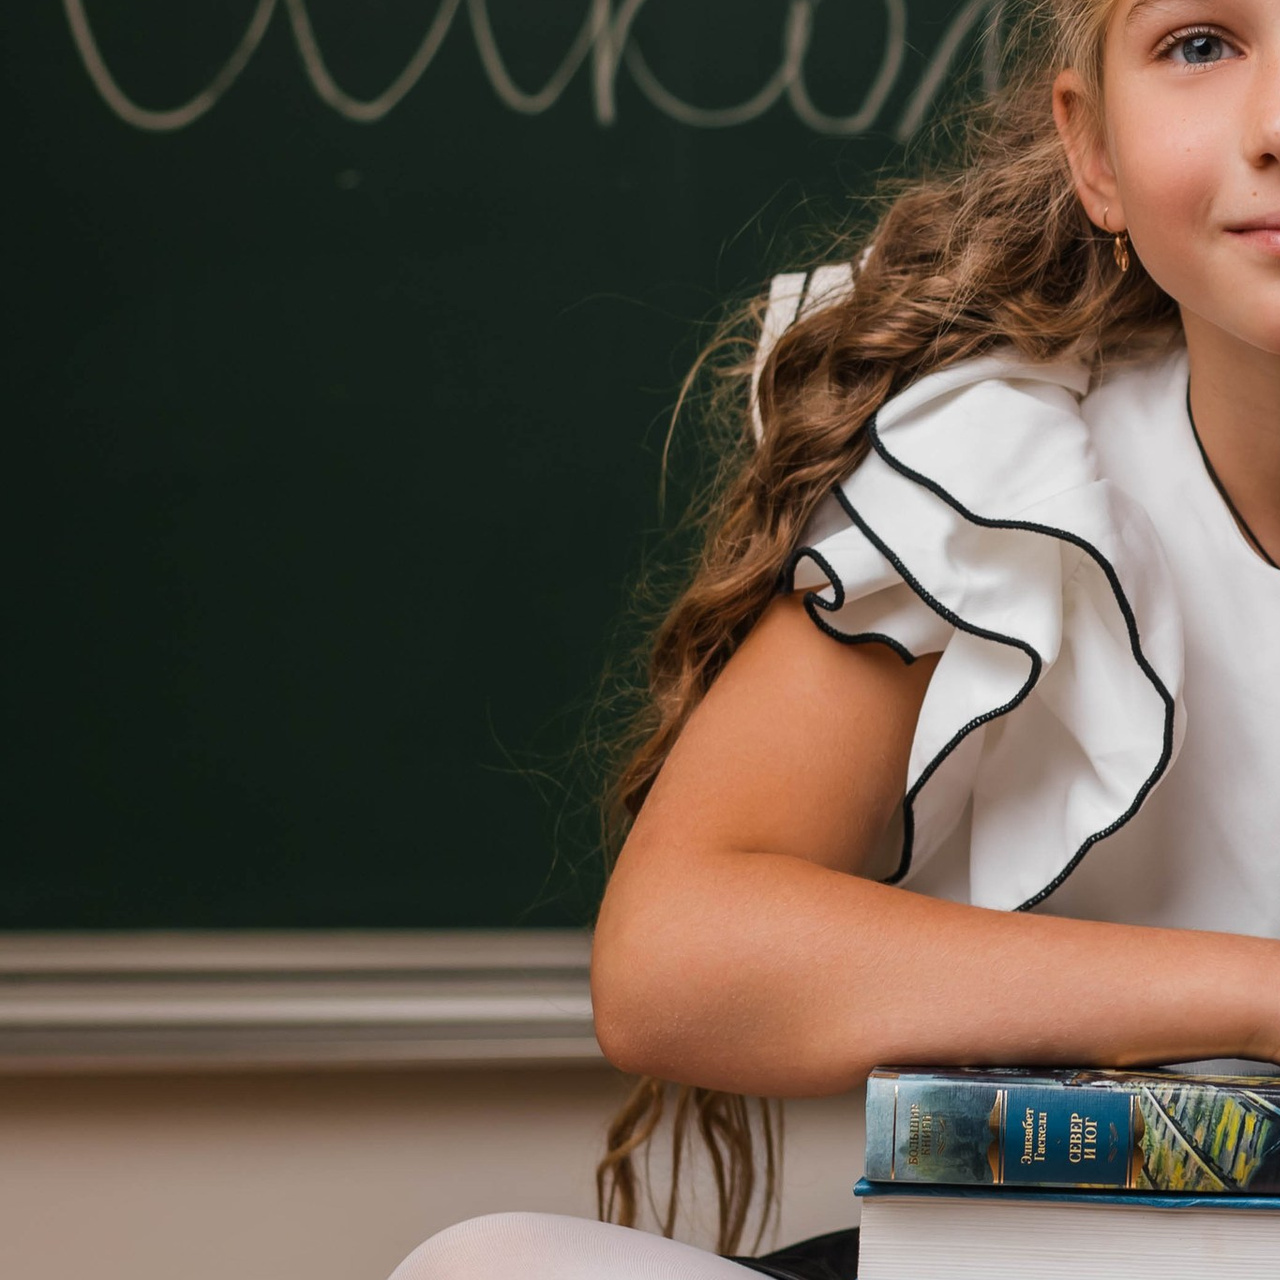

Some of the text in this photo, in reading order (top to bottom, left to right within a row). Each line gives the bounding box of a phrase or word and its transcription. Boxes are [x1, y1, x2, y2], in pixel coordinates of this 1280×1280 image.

[1020, 1107, 1034, 1165] Элизабет
[1033, 1112, 1047, 1161] Гаскелл
[1069, 1112, 1083, 1163] СЕВЕР
[1083, 1116, 1098, 1160] И ЮГ
